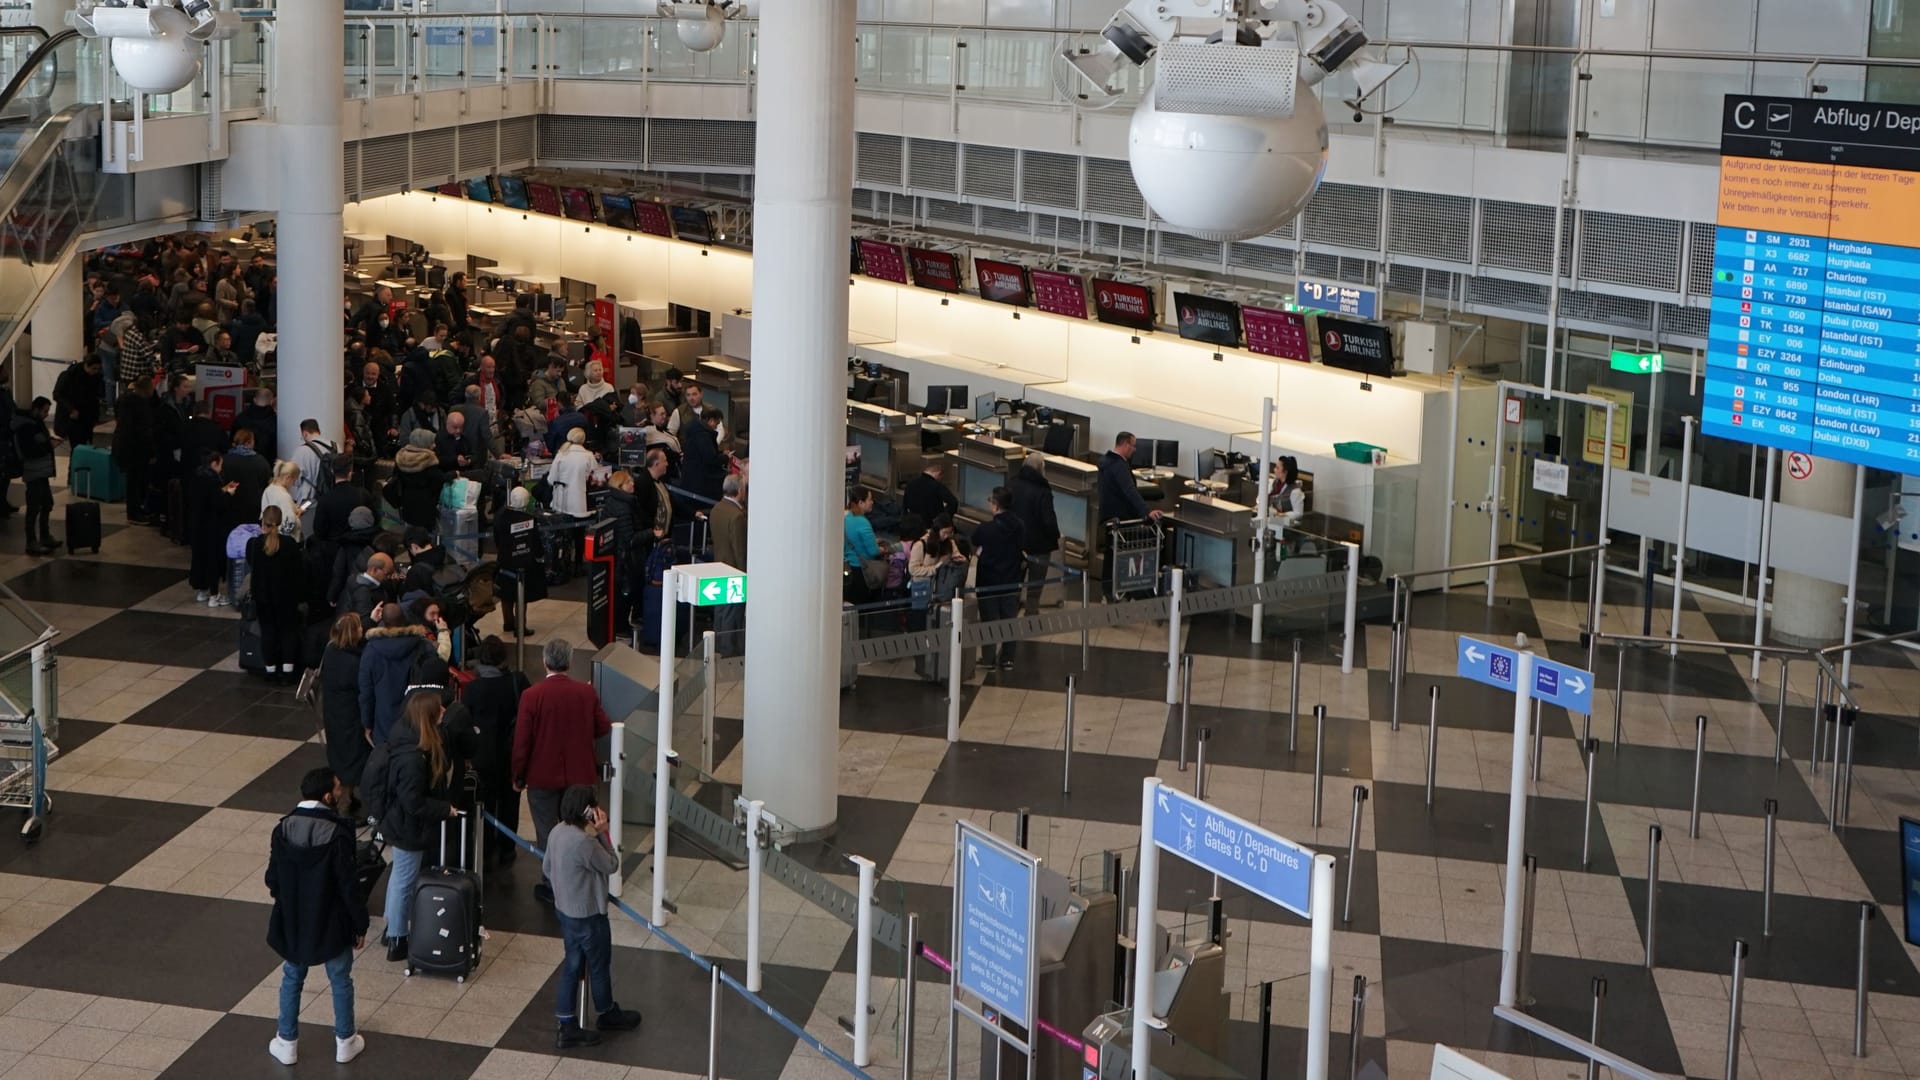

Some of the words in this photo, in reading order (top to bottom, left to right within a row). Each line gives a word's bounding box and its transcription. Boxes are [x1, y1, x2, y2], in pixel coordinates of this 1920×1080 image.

[1734, 102, 1755, 129] C
[1814, 106, 1870, 131] Abflug
[1873, 110, 1882, 128] /
[1770, 140, 1782, 148] Flug
[1770, 148, 1784, 157] Flight
[1726, 160, 1761, 170] Aufgrund
[1764, 163, 1776, 171] der
[1779, 164, 1842, 177] Wettersituation
[1844, 170, 1858, 179] der
[1860, 171, 1889, 181] letzten
[1892, 174, 1914, 185] Tage
[1723, 188, 1804, 203] Unregelmäßigkeiten
[1763, 178, 1782, 186] noch
[1784, 179, 1810, 188] immer
[1825, 183, 1866, 194] schweren
[1722, 201, 1736, 210] Wir
[1737, 204, 1759, 212] bitten
[1762, 206, 1774, 214] um
[1766, 235, 1780, 244] SM
[1789, 238, 1810, 248] 2931
[1828, 242, 1872, 255] Hurghada
[1828, 257, 1871, 270] Hurghada
[993, 272, 1018, 282] TURKISH
[1764, 264, 1776, 272] AA
[1792, 267, 1808, 276] 717
[1826, 271, 1867, 284] Charlotte
[995, 280, 1021, 291] AIRLINES
[1313, 284, 1322, 300] D
[1764, 278, 1775, 286] TK
[1825, 286, 1861, 298] Istanbul
[1863, 290, 1886, 303] (IST)
[1113, 293, 1142, 305] TURKISH
[1115, 303, 1144, 314] AIRLINES
[1762, 291, 1774, 301] TK
[1785, 294, 1806, 304] 7739
[1824, 300, 1859, 312] Istanbul
[1862, 304, 1892, 319] (SAW)
[1197, 309, 1228, 320] TURKISH
[1761, 306, 1773, 316] EK
[1823, 315, 1849, 326] Dubai
[1852, 319, 1879, 332] (DXB)
[1198, 319, 1230, 331] AIRLINES
[1760, 320, 1772, 330] TK
[1783, 324, 1804, 334] 1634
[1822, 329, 1857, 342] Istanbul
[1860, 335, 1883, 348] (IST)
[1343, 334, 1380, 348] TURKISH
[1345, 344, 1381, 358] AIRLINES
[1759, 334, 1771, 343] EY
[1820, 344, 1838, 354] Abu
[1841, 347, 1867, 358] Dhabi
[1758, 348, 1776, 358] EZY
[1780, 352, 1802, 362] 3264
[1820, 358, 1865, 374] Edinburgh
[1757, 363, 1770, 372] QR
[1818, 373, 1842, 384] Doha
[1755, 377, 1767, 386] BA
[1783, 382, 1799, 392] 955
[1817, 388, 1849, 400] London
[1853, 394, 1880, 407] (LHR)
[1755, 391, 1766, 400] TK
[1816, 402, 1851, 415] Istanbul
[1854, 409, 1877, 421] (IST)
[1753, 404, 1770, 415] EZY
[1815, 417, 1848, 430] London
[1850, 423, 1880, 437] (LGW)
[1752, 419, 1764, 428] EK
[1780, 424, 1796, 434] 052
[1813, 430, 1840, 442] Dubai
[1842, 436, 1869, 449] (DXB)
[1204, 815, 1235, 844] Abflug
[1237, 830, 1243, 845] /
[1245, 832, 1298, 870] Departures
[1204, 832, 1231, 857] Gates
[1234, 844, 1243, 864] B,
[1247, 851, 1256, 870] C,
[1260, 857, 1268, 873] D
